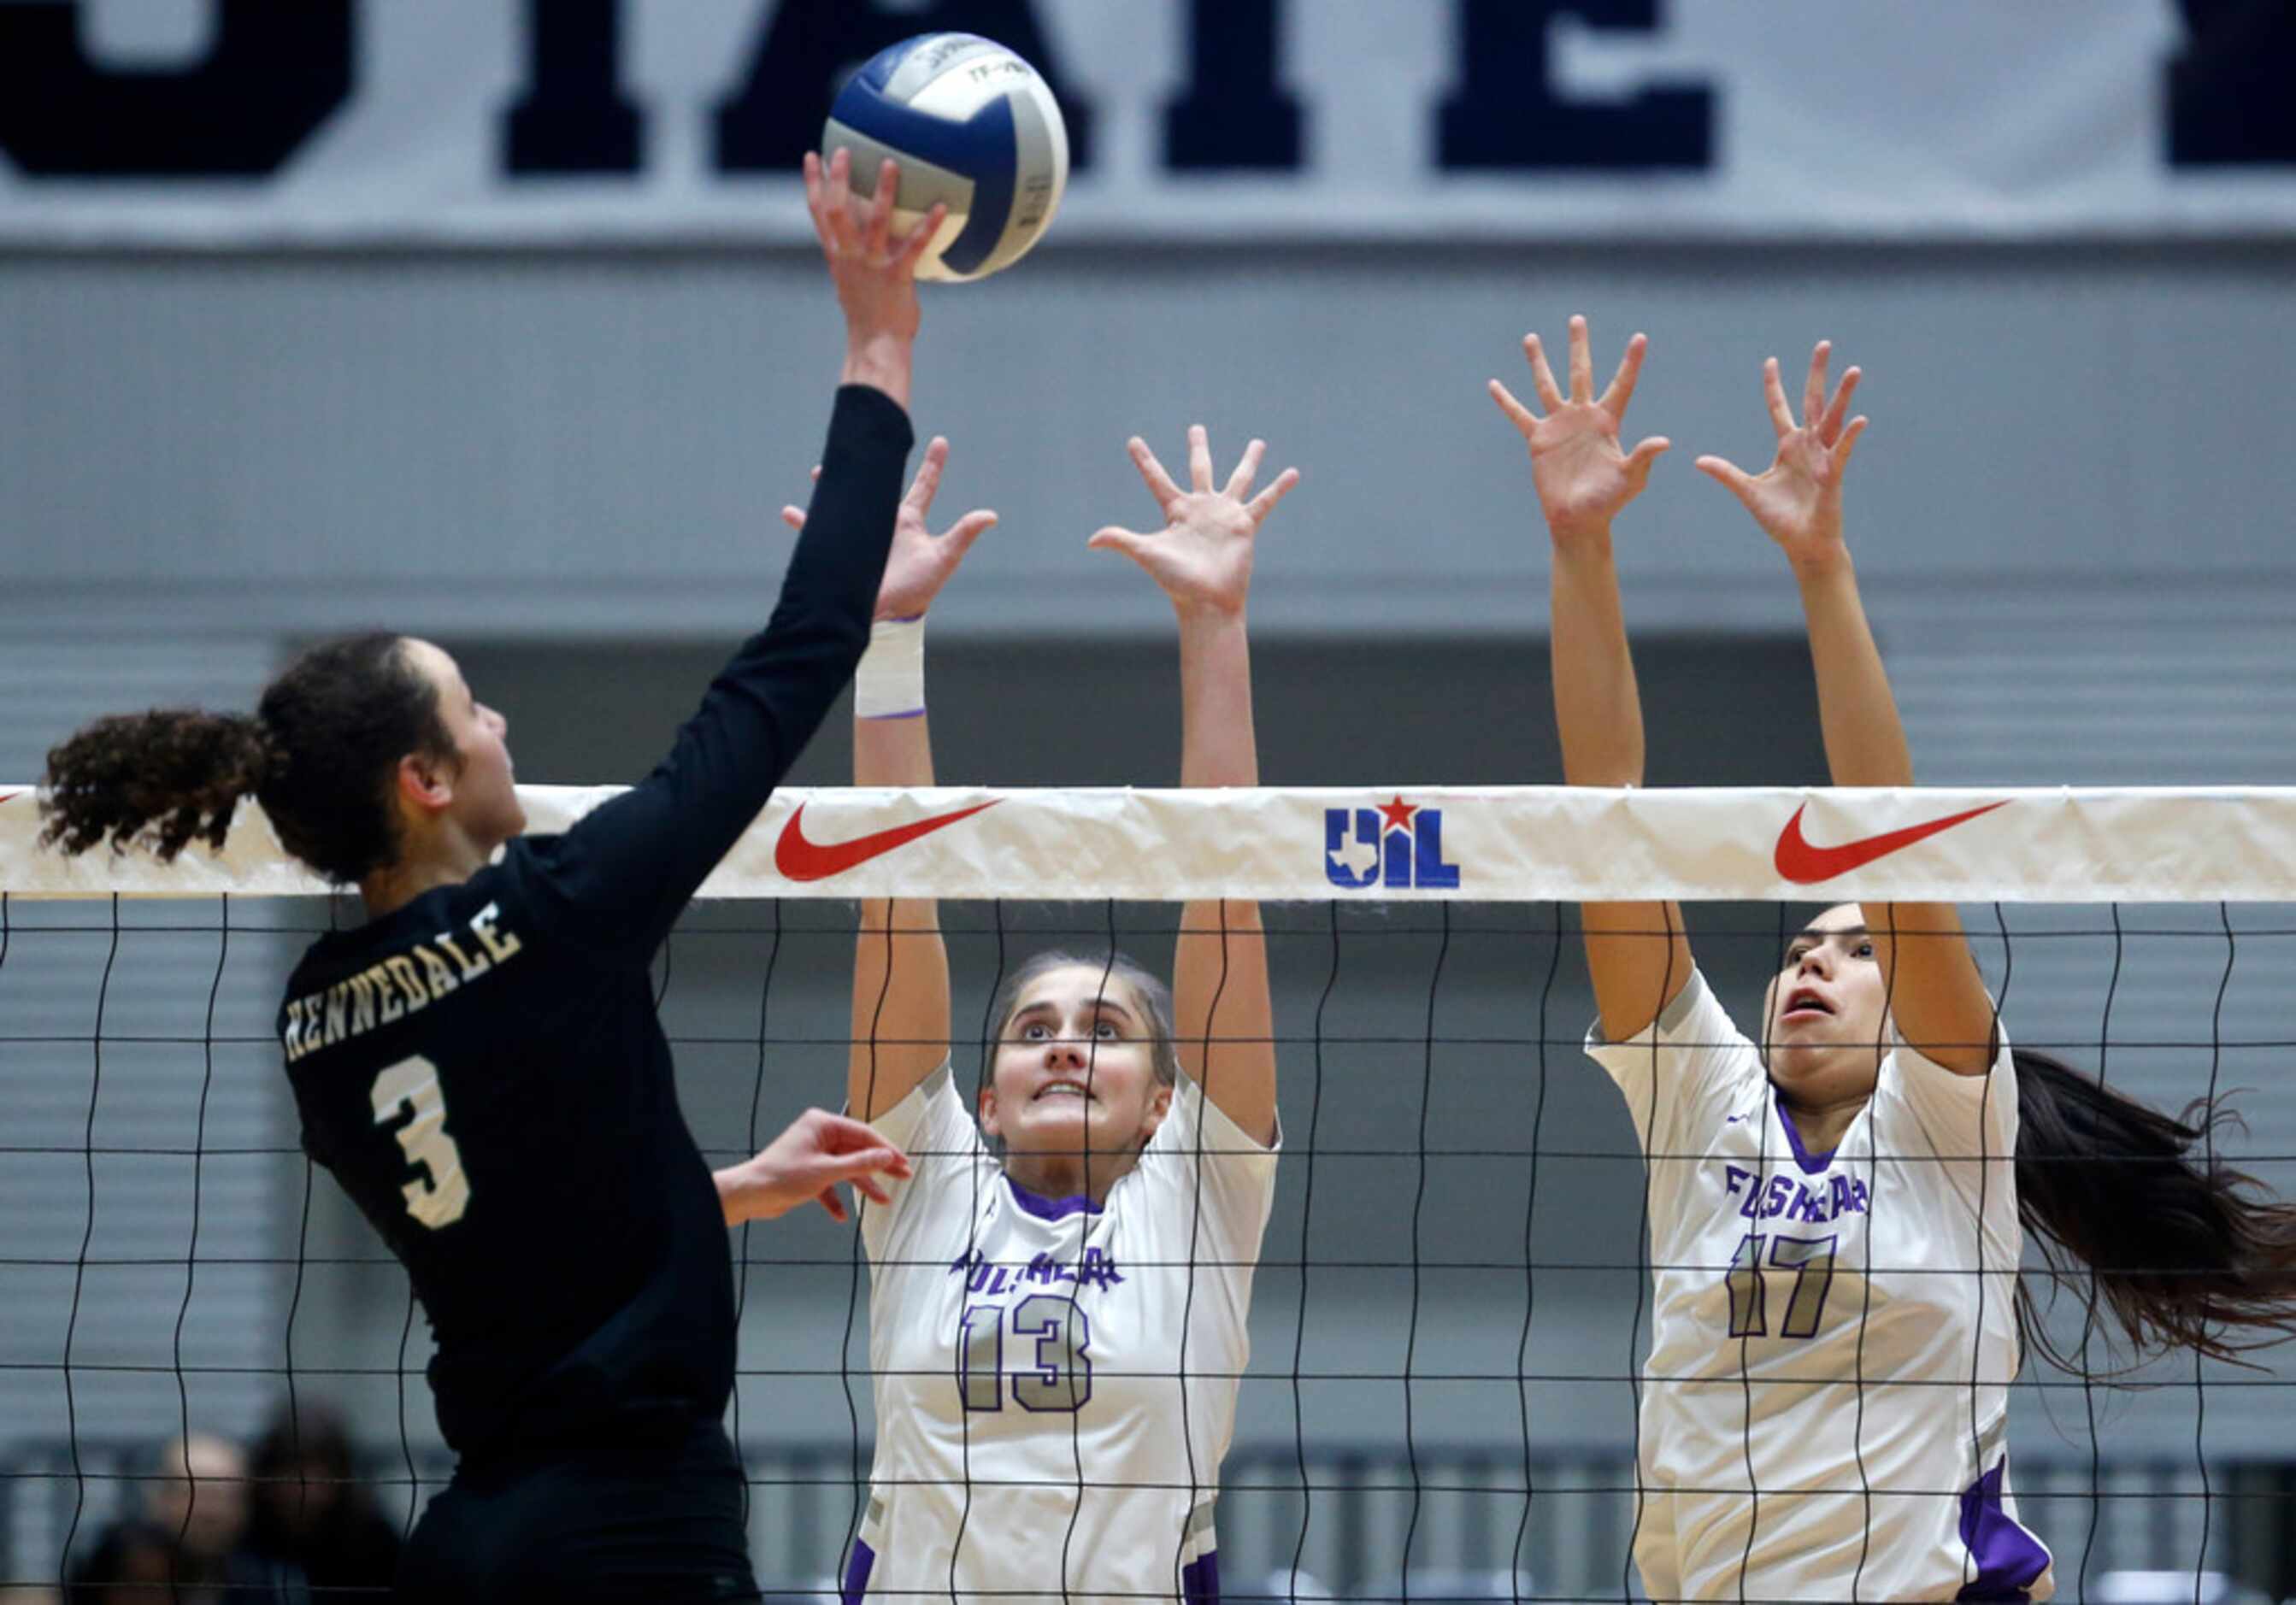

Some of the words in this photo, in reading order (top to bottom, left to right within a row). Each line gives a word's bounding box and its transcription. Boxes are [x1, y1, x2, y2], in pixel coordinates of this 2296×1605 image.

[1325, 795, 1460, 889] UIL
[370, 1054, 470, 1230] 3
[1724, 1233, 1839, 1339] 17
[961, 1294, 1092, 1412] 13
